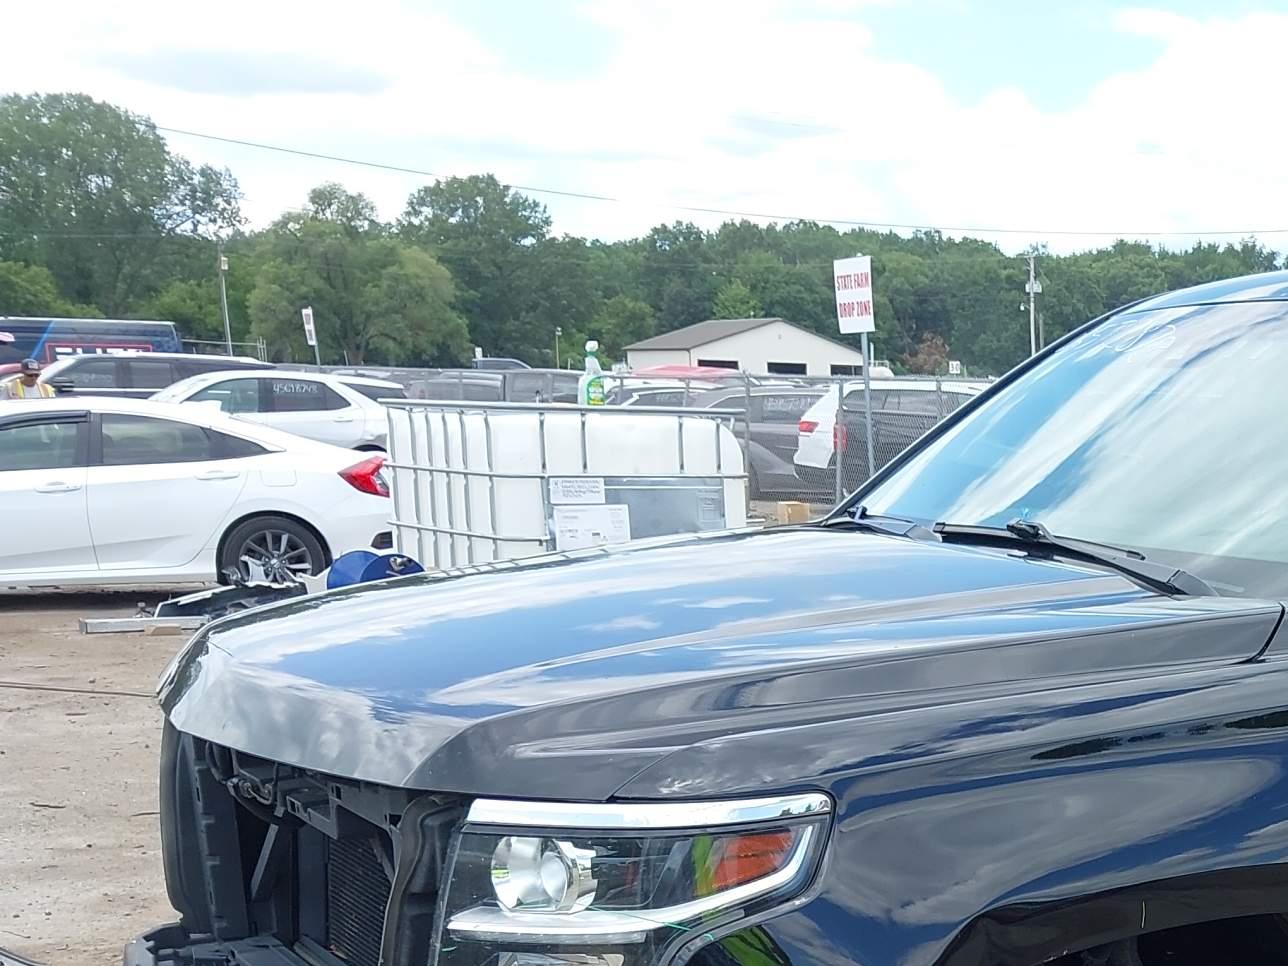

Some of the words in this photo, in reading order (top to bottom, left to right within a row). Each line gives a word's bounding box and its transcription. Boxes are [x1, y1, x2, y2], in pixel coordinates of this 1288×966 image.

[837, 274, 853, 291] STATE
[854, 272, 870, 289] FARM
[839, 302, 855, 318] DROP
[856, 300, 871, 317] ZONE
